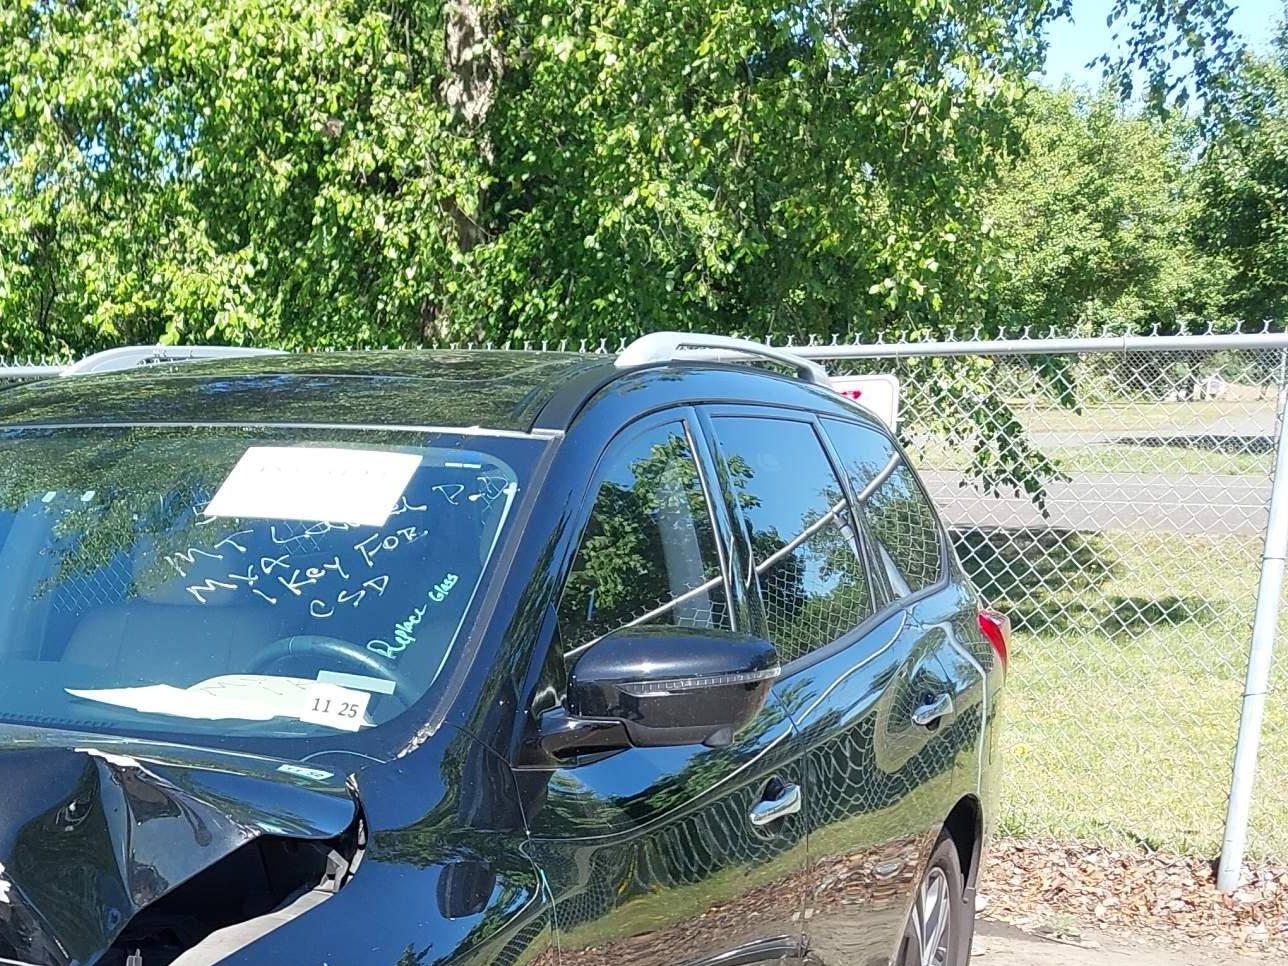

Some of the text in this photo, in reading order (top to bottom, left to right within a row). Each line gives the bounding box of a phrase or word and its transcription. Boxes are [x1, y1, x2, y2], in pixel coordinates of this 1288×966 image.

[428, 573, 459, 602] Glass
[312, 697, 359, 718] 11 25
